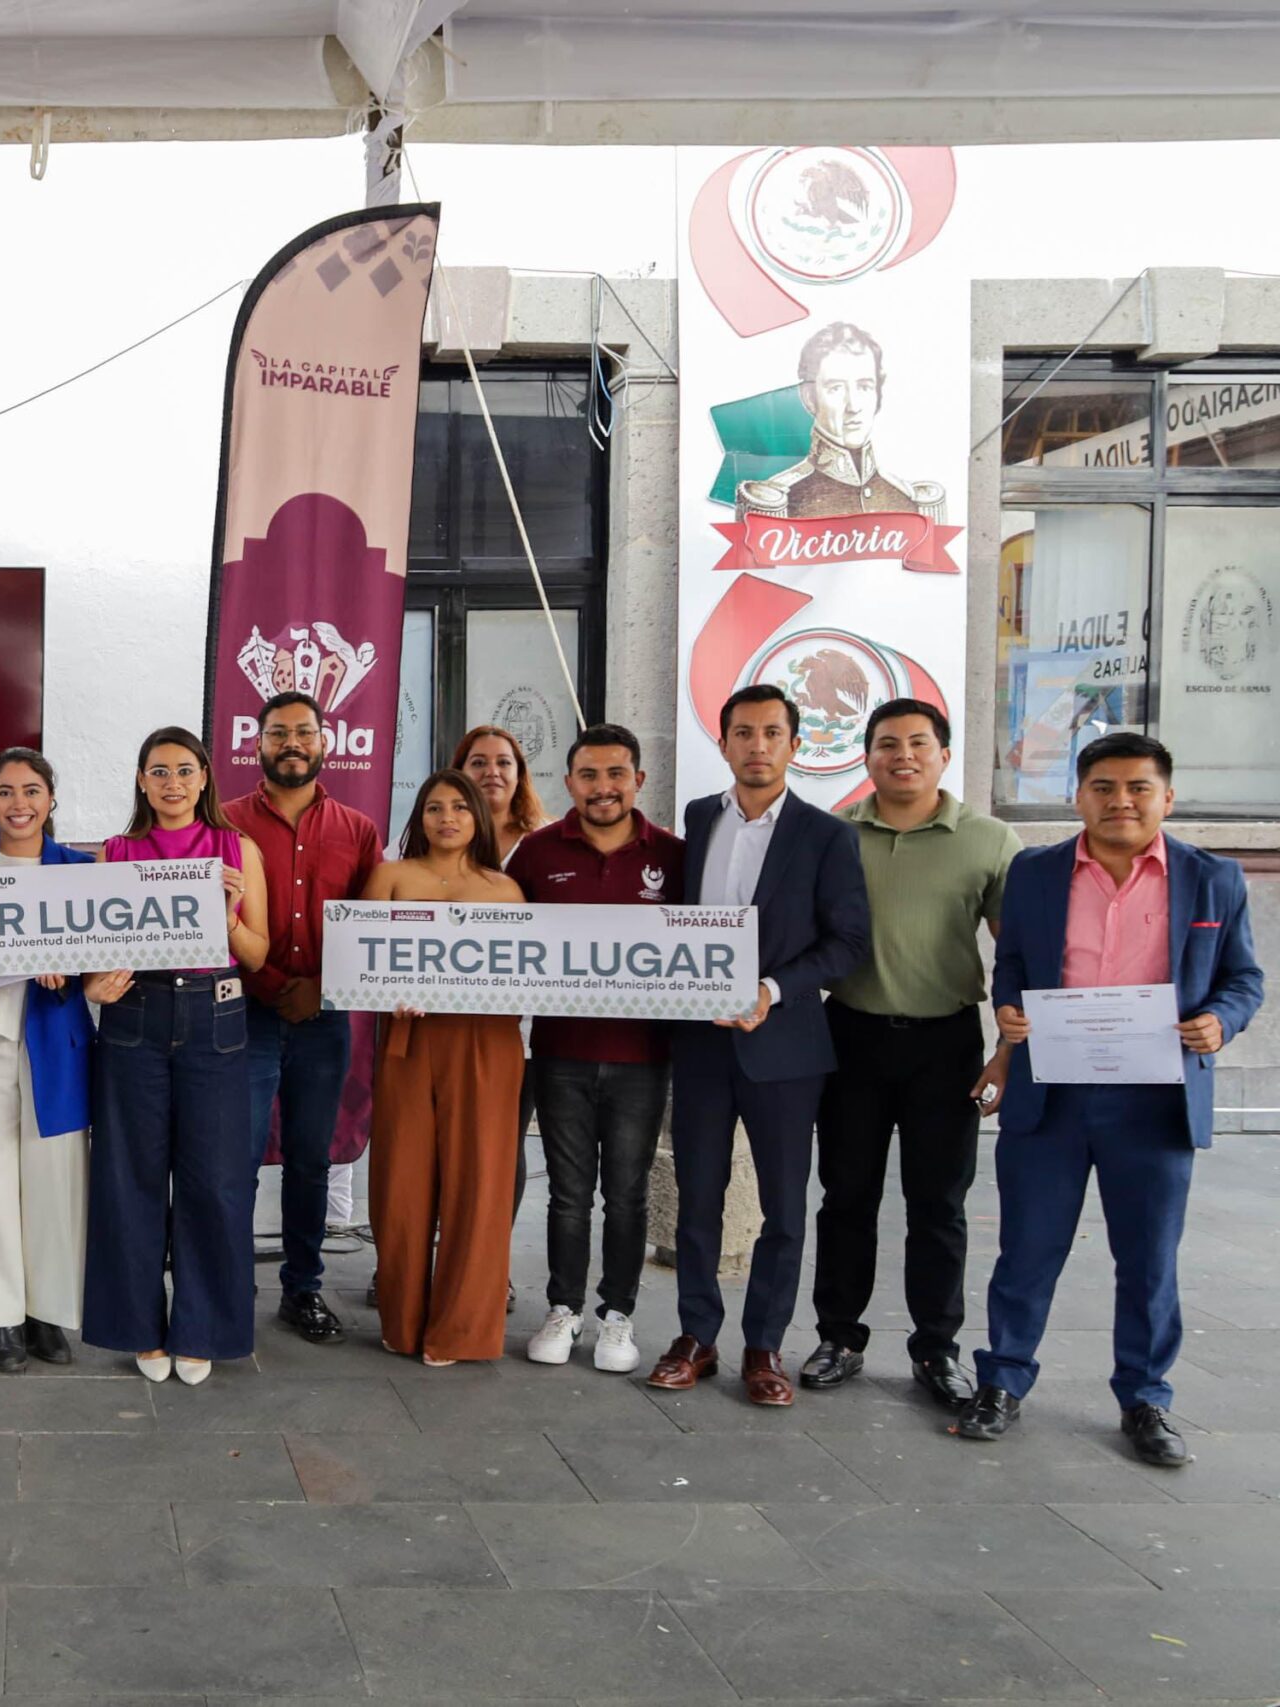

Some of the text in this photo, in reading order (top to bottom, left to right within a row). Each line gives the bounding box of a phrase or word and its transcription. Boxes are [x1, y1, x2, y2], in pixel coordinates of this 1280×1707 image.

[271, 357, 380, 379] LA CAPITAL
[261, 369, 391, 398] IMPARABLE
[759, 524, 908, 561] Victoria
[328, 761, 372, 770] CIUDAD
[140, 870, 211, 882] IMPARABLE
[39, 895, 201, 935] LUGAR
[353, 909, 389, 919] Puebla
[470, 912, 533, 921] JUVENTUD
[666, 917, 745, 928] IMPARABLE
[8, 935, 63, 948] Juventud
[65, 935, 83, 945] del
[86, 933, 143, 946] Municipio
[145, 932, 160, 942] de
[163, 930, 203, 941] Puebla
[358, 937, 735, 979] TERCER LUGAR
[360, 973, 732, 992] Por parte del Instituto de la Juventud del Municipio de Puebla
